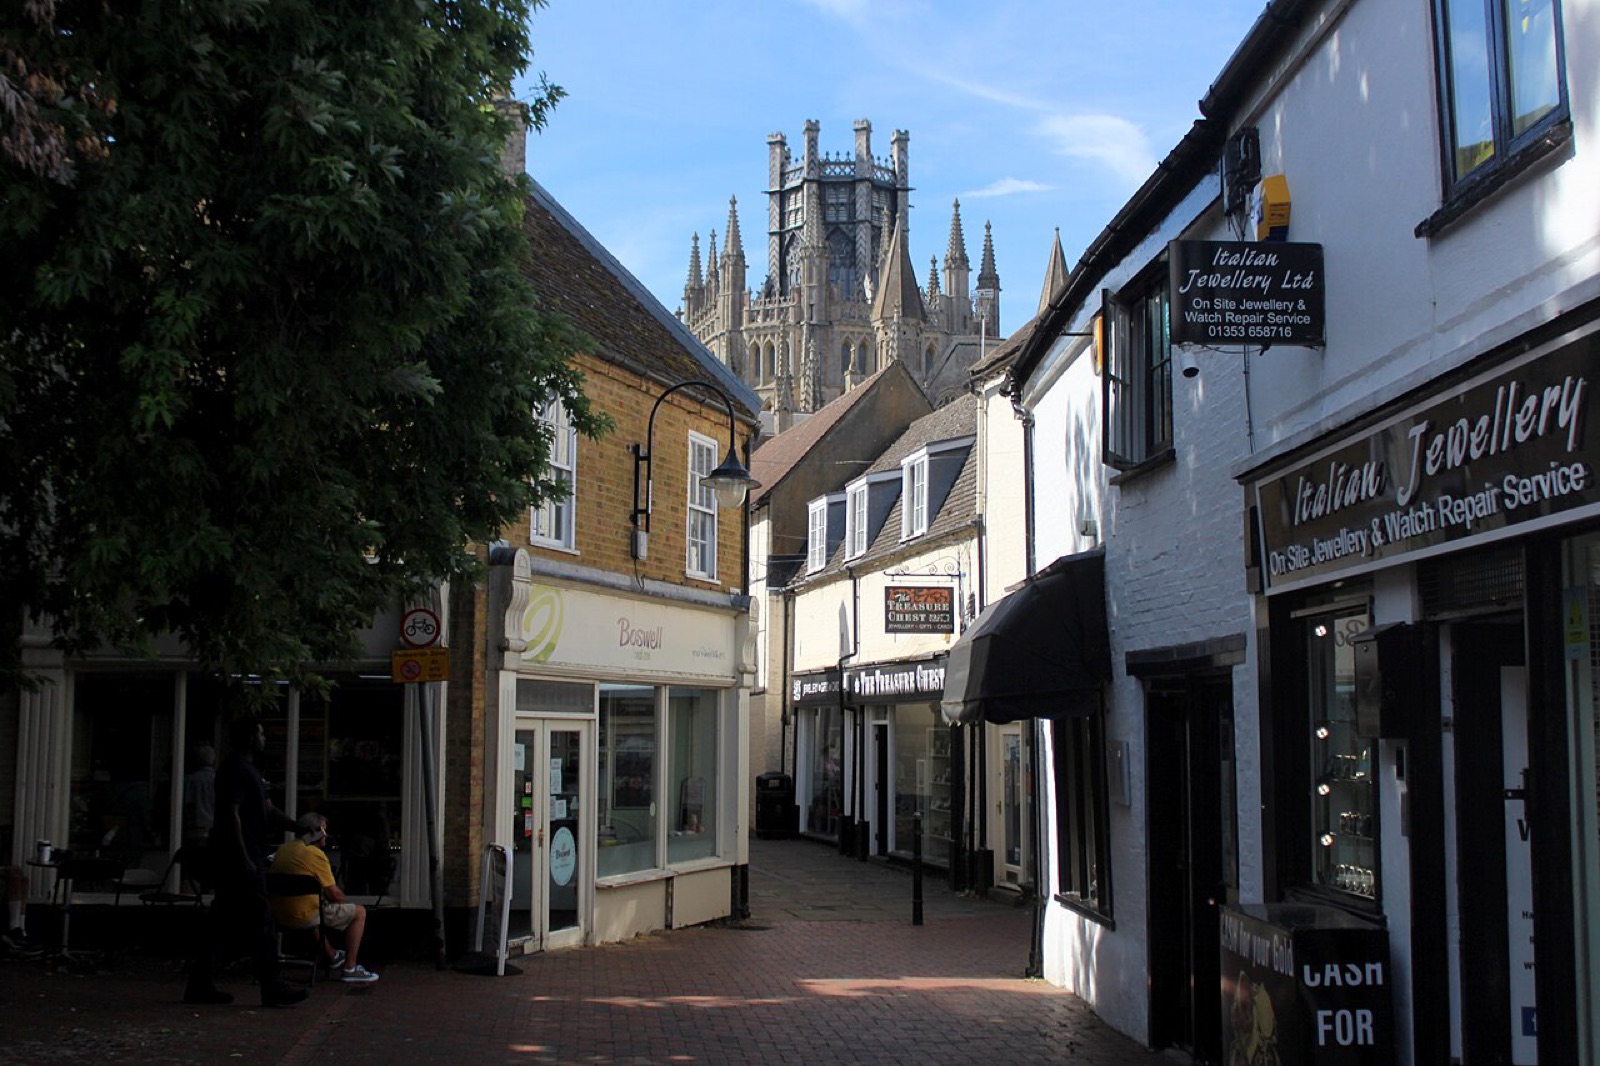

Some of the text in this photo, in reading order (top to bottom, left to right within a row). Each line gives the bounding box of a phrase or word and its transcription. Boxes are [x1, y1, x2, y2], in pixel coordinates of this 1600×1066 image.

[1212, 246, 1280, 267] Italian
[1178, 269, 1315, 295] Jewellery Ltd
[1184, 311, 1311, 326] Watch Repair Service
[1192, 299, 1306, 313] On Site Jewellery &
[1208, 325, 1292, 338] 01353 658716
[1294, 375, 1585, 527] Italian Jewellery
[1269, 460, 1586, 576] On Site Jewellery & Watch Repair Service
[887, 600, 950, 611] TREASURE
[888, 611, 926, 622] CHEST
[617, 617, 663, 650] Boswell
[916, 664, 945, 693] CHEST
[1303, 961, 1385, 988] CASH
[1316, 1008, 1375, 1047] FOR
